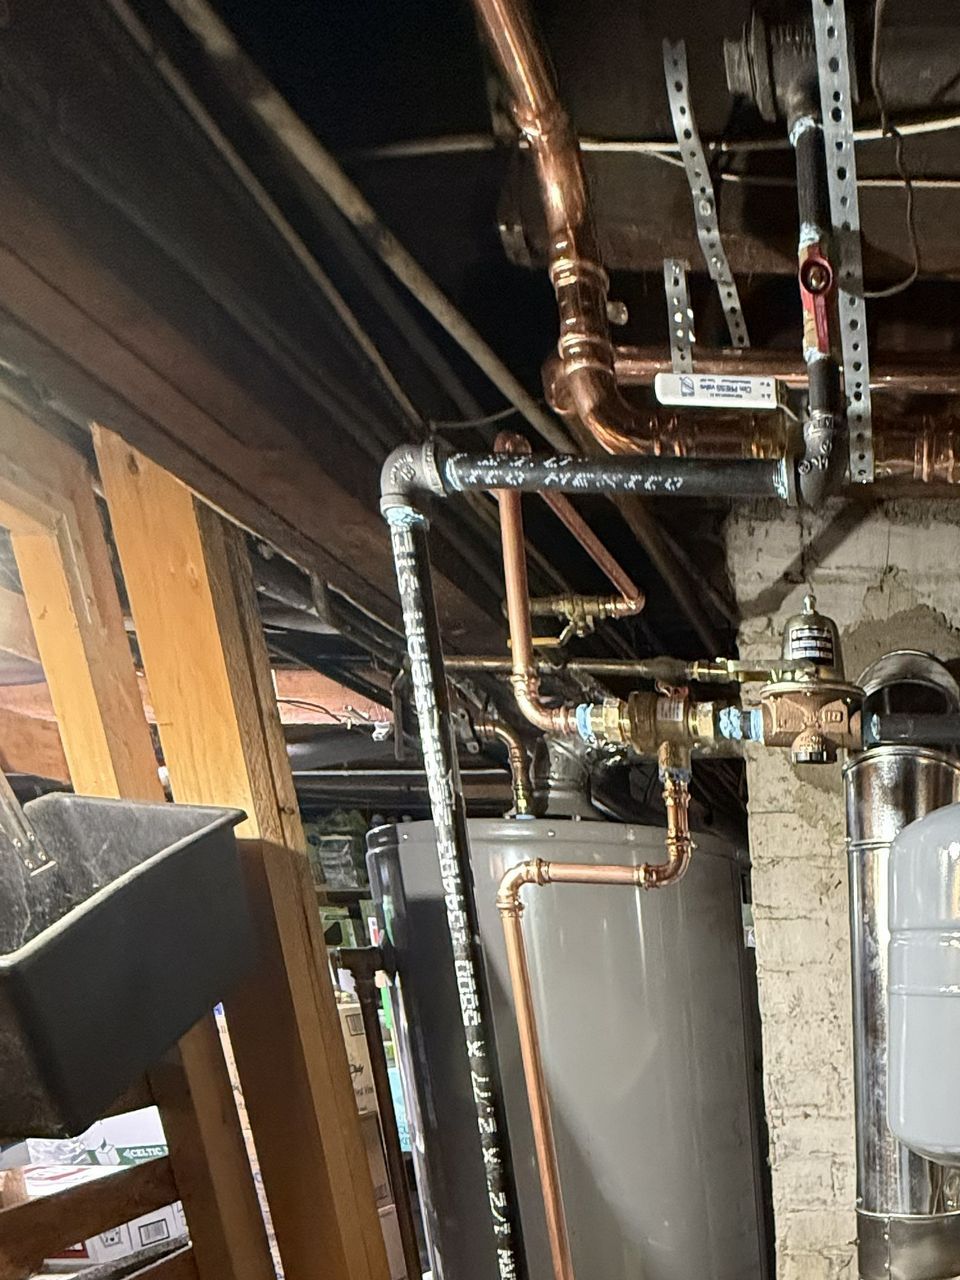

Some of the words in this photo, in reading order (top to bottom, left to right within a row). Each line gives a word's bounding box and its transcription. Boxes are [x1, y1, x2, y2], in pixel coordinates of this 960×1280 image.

[455, 959, 478, 1026] 5800
[465, 1040, 484, 1056] X
[469, 1070, 496, 1133] 2.77
[130, 1147, 162, 1157] CELTIC
[482, 1146, 500, 1163] X
